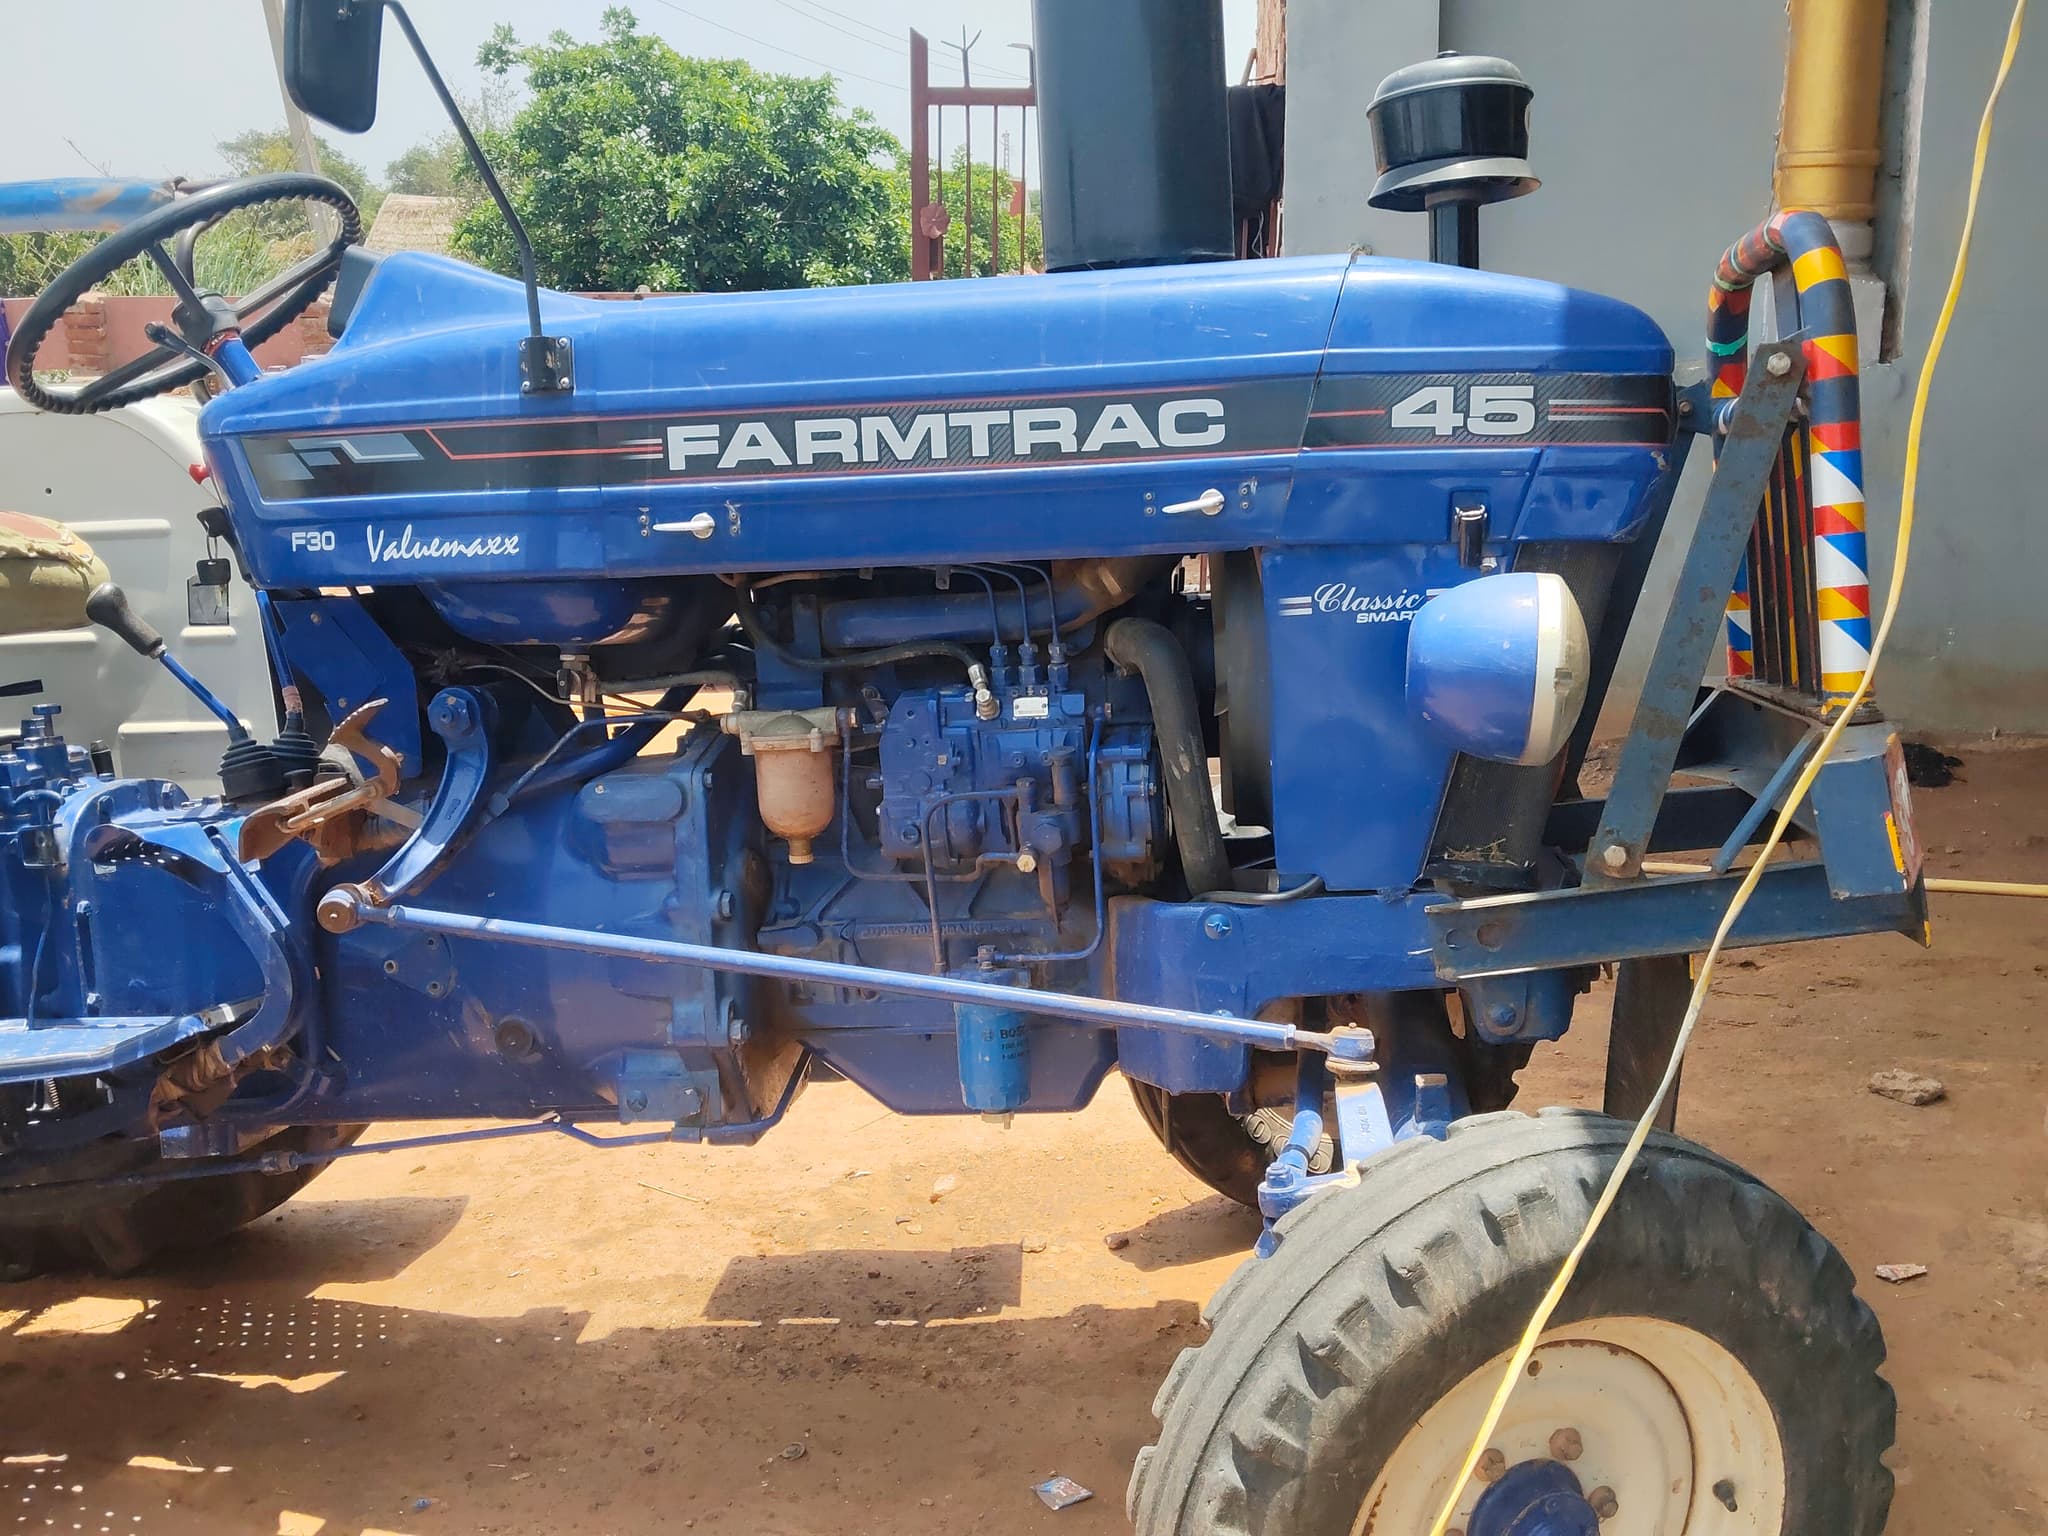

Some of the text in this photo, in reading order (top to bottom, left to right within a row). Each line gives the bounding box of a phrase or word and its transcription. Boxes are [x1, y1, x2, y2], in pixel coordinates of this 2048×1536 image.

[1390, 385, 1536, 436] 45
[667, 398, 1226, 471] FARMTRAC
[290, 530, 336, 553] F30
[366, 523, 520, 563] Valuemaxx
[1314, 583, 1425, 613] Classic
